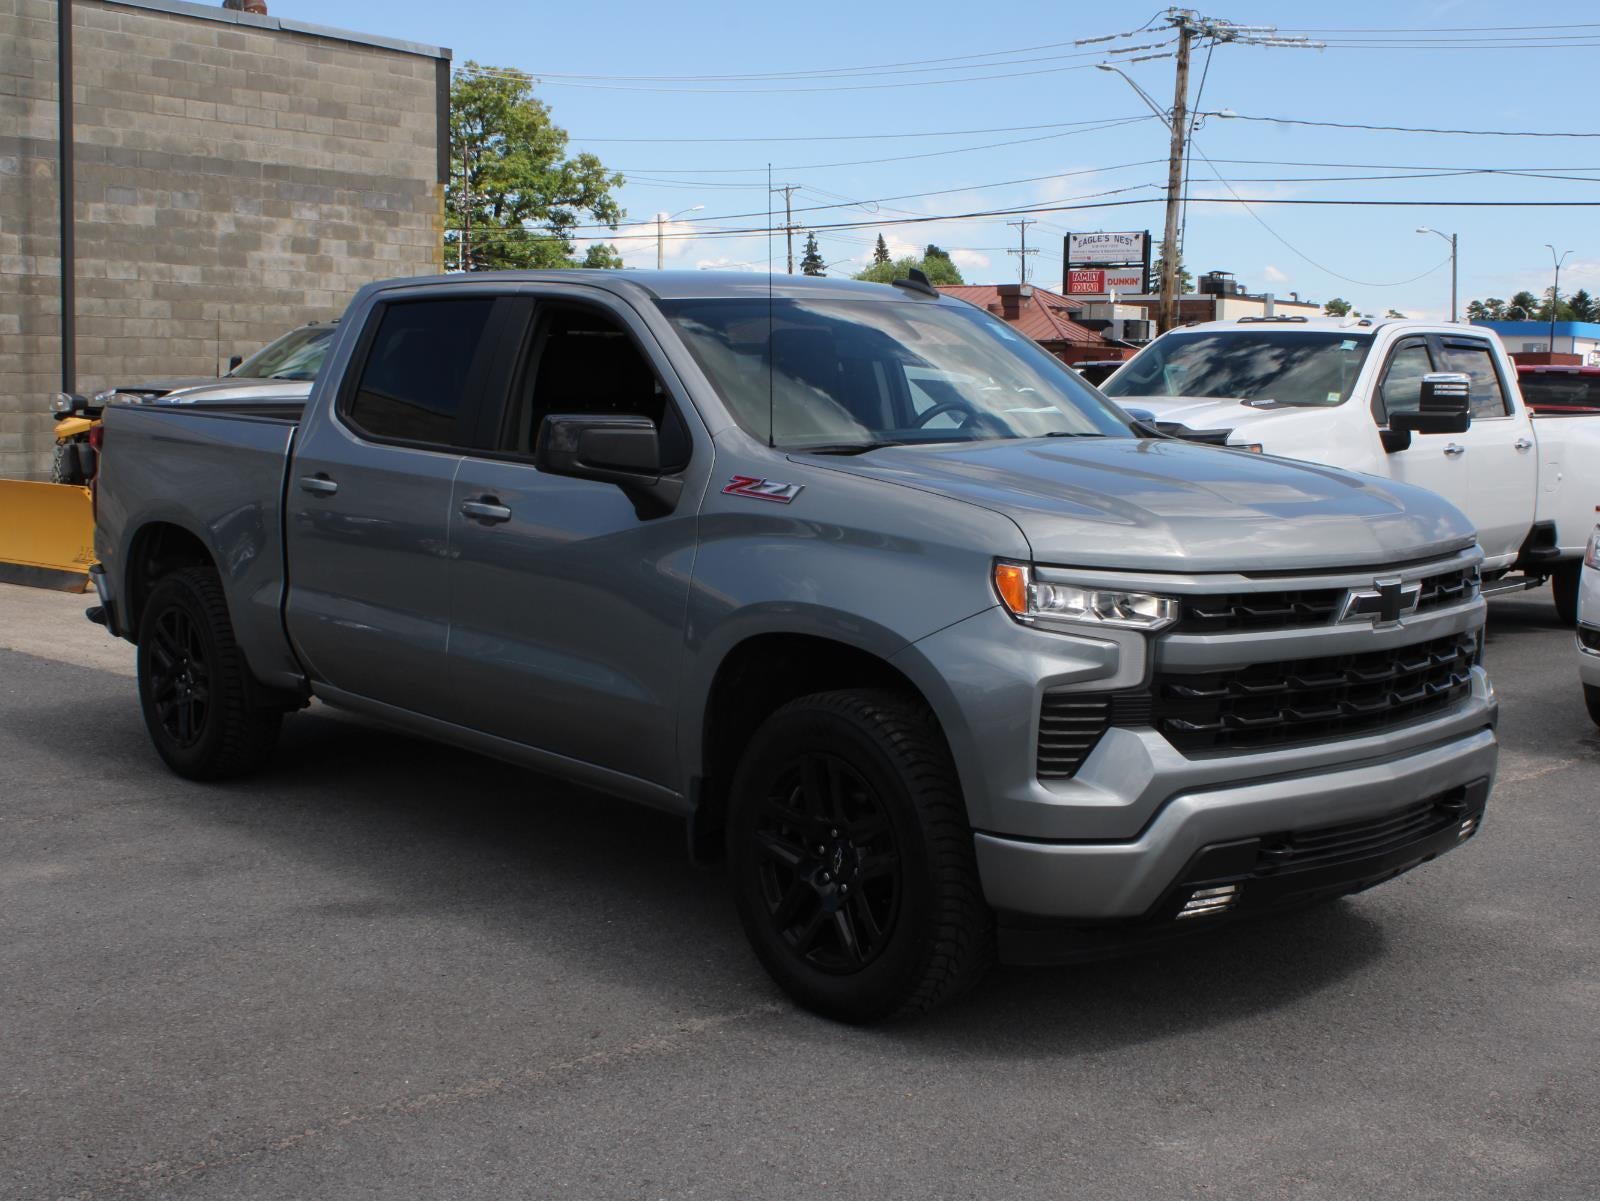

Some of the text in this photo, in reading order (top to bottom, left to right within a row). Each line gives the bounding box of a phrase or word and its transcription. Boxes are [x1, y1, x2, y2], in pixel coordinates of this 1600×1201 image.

[1078, 235, 1133, 248] EAGLE'S NEST
[1073, 271, 1100, 281] FAMILY
[1107, 277, 1140, 286] DUNKIN'
[1072, 282, 1099, 293] DOLLAR
[721, 475, 806, 504] Z71
